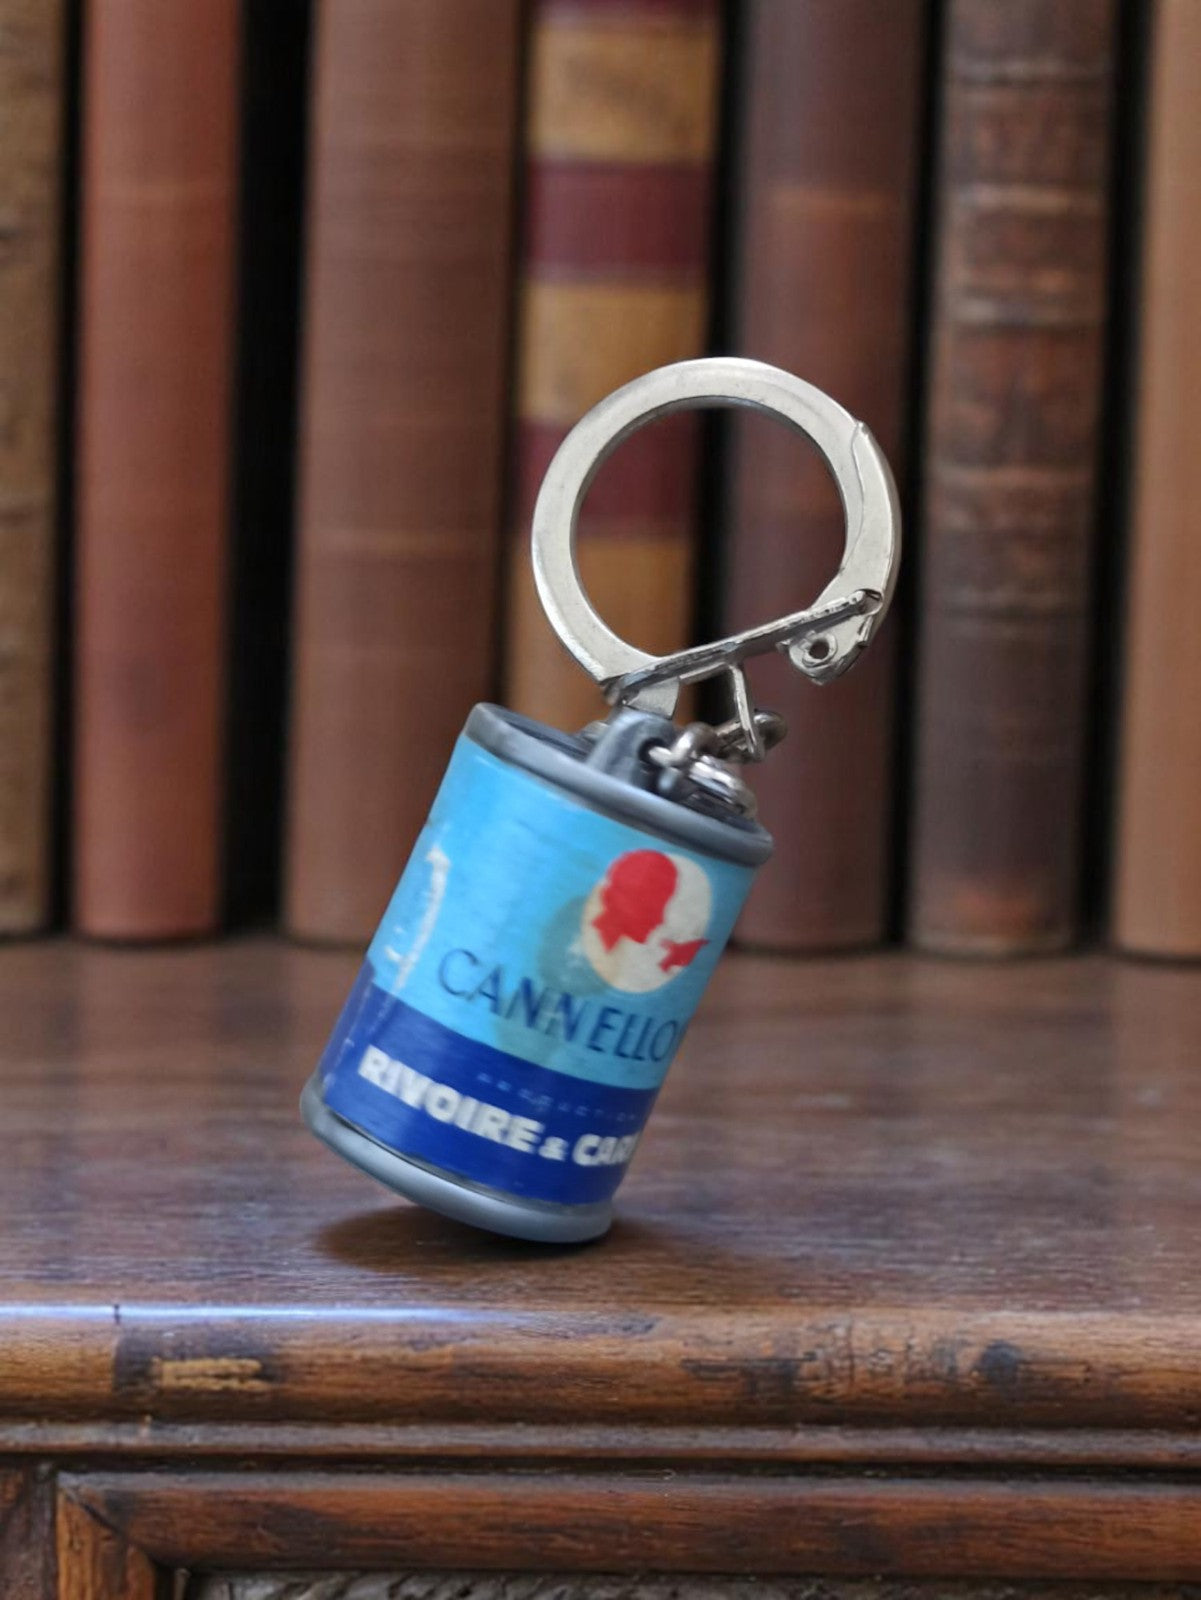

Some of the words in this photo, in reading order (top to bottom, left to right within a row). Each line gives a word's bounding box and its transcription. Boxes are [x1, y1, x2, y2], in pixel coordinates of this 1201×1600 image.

[437, 948, 686, 1063] CANNELLO
[357, 1044, 547, 1154] RIVOIRE
[538, 1135, 570, 1162] &
